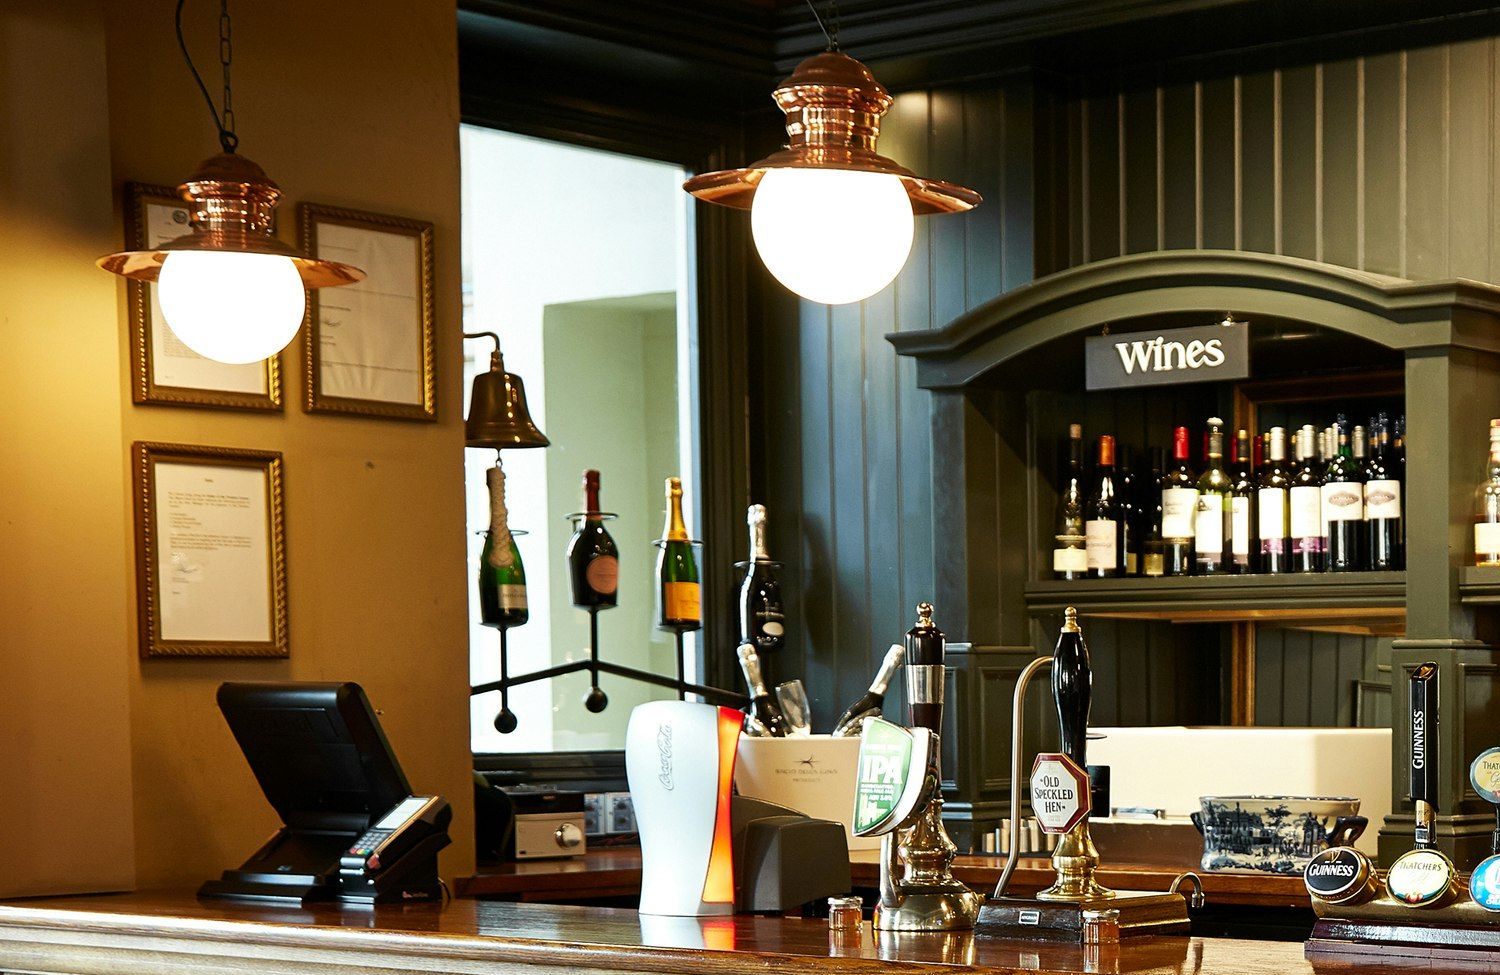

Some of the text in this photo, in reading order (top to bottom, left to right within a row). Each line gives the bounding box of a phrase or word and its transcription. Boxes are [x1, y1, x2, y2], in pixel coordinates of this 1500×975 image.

[1115, 335, 1225, 375] Wines
[1412, 710, 1424, 769] GUINNESS
[863, 754, 903, 785] IPA
[1043, 775, 1060, 788] OLD
[1034, 787, 1074, 800] SPECKLED
[1045, 801, 1062, 813] HEN
[1308, 863, 1354, 877] GUINNESS
[1400, 861, 1443, 872] THATCHERS
